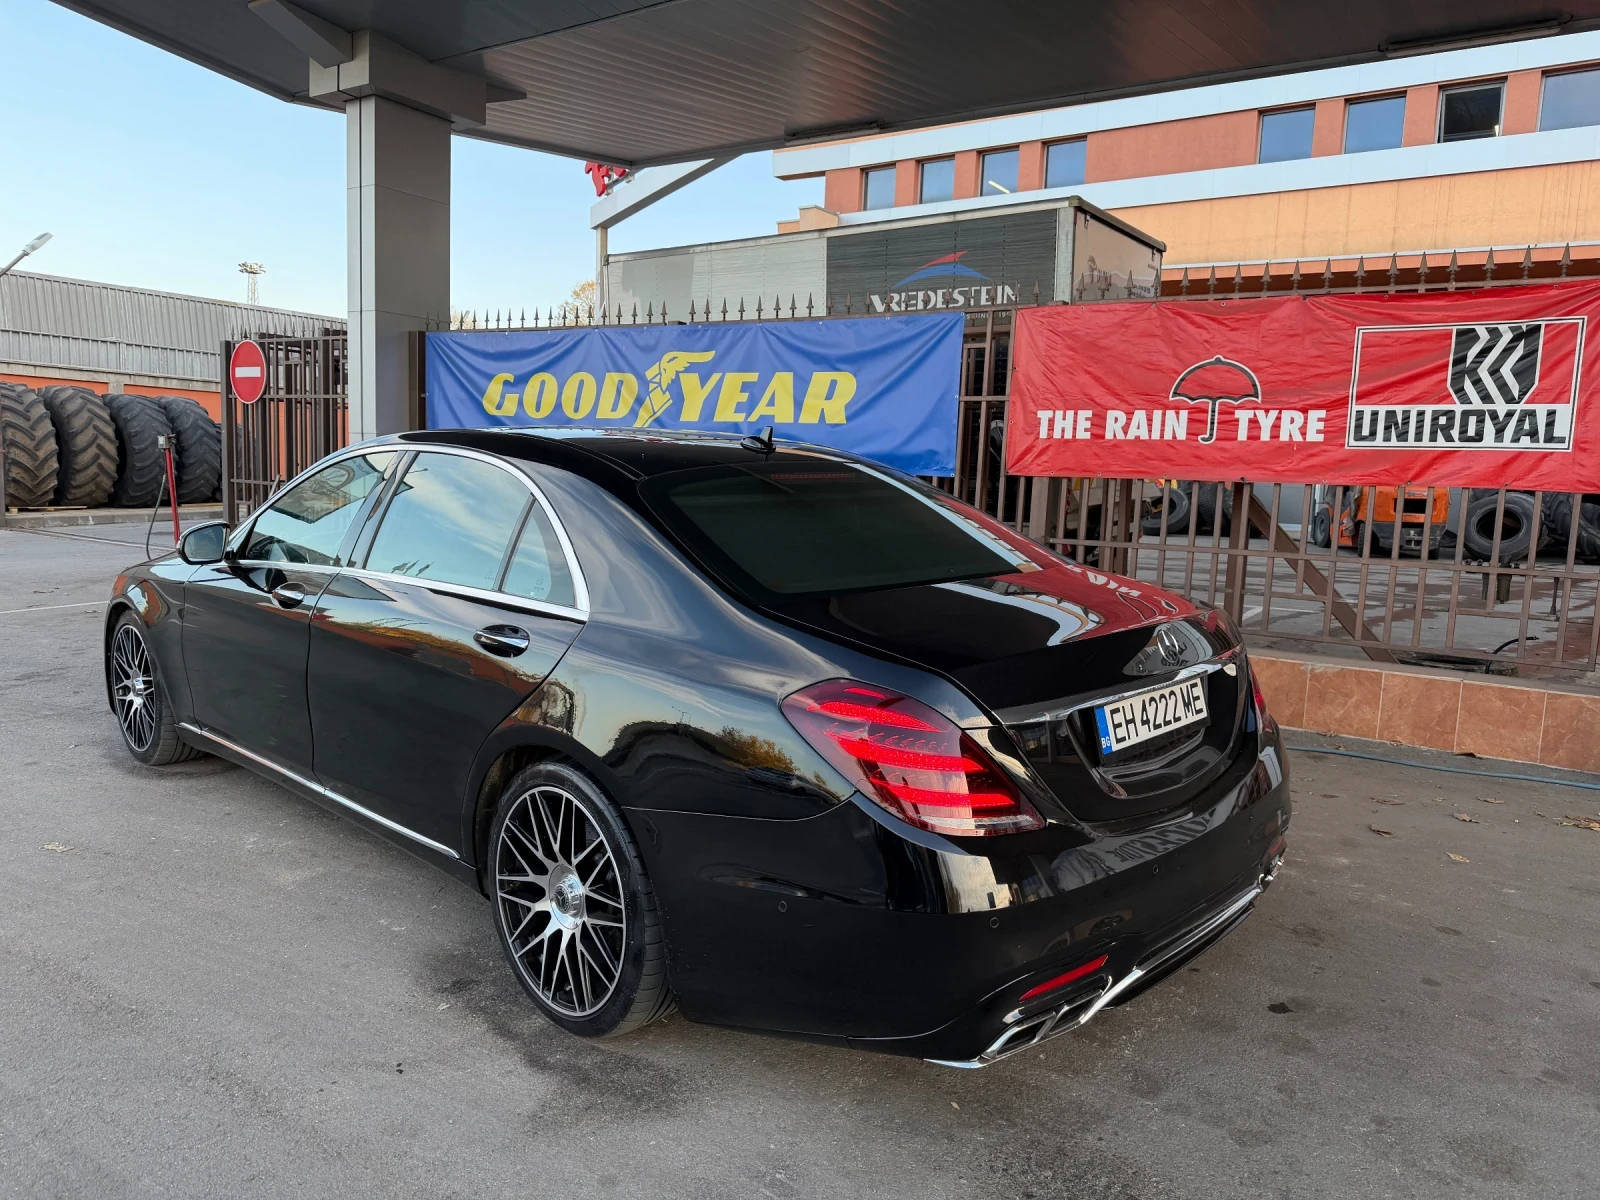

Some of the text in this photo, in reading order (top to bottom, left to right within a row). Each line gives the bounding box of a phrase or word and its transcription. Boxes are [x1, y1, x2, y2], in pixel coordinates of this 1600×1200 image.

[870, 284, 1018, 313] VREDESTEIN
[482, 371, 857, 424] GOOD YEAR
[1037, 410, 1326, 442] THE RAIN TYRE
[1353, 409, 1566, 444] UNIROYAL
[1101, 736, 1112, 749] BG
